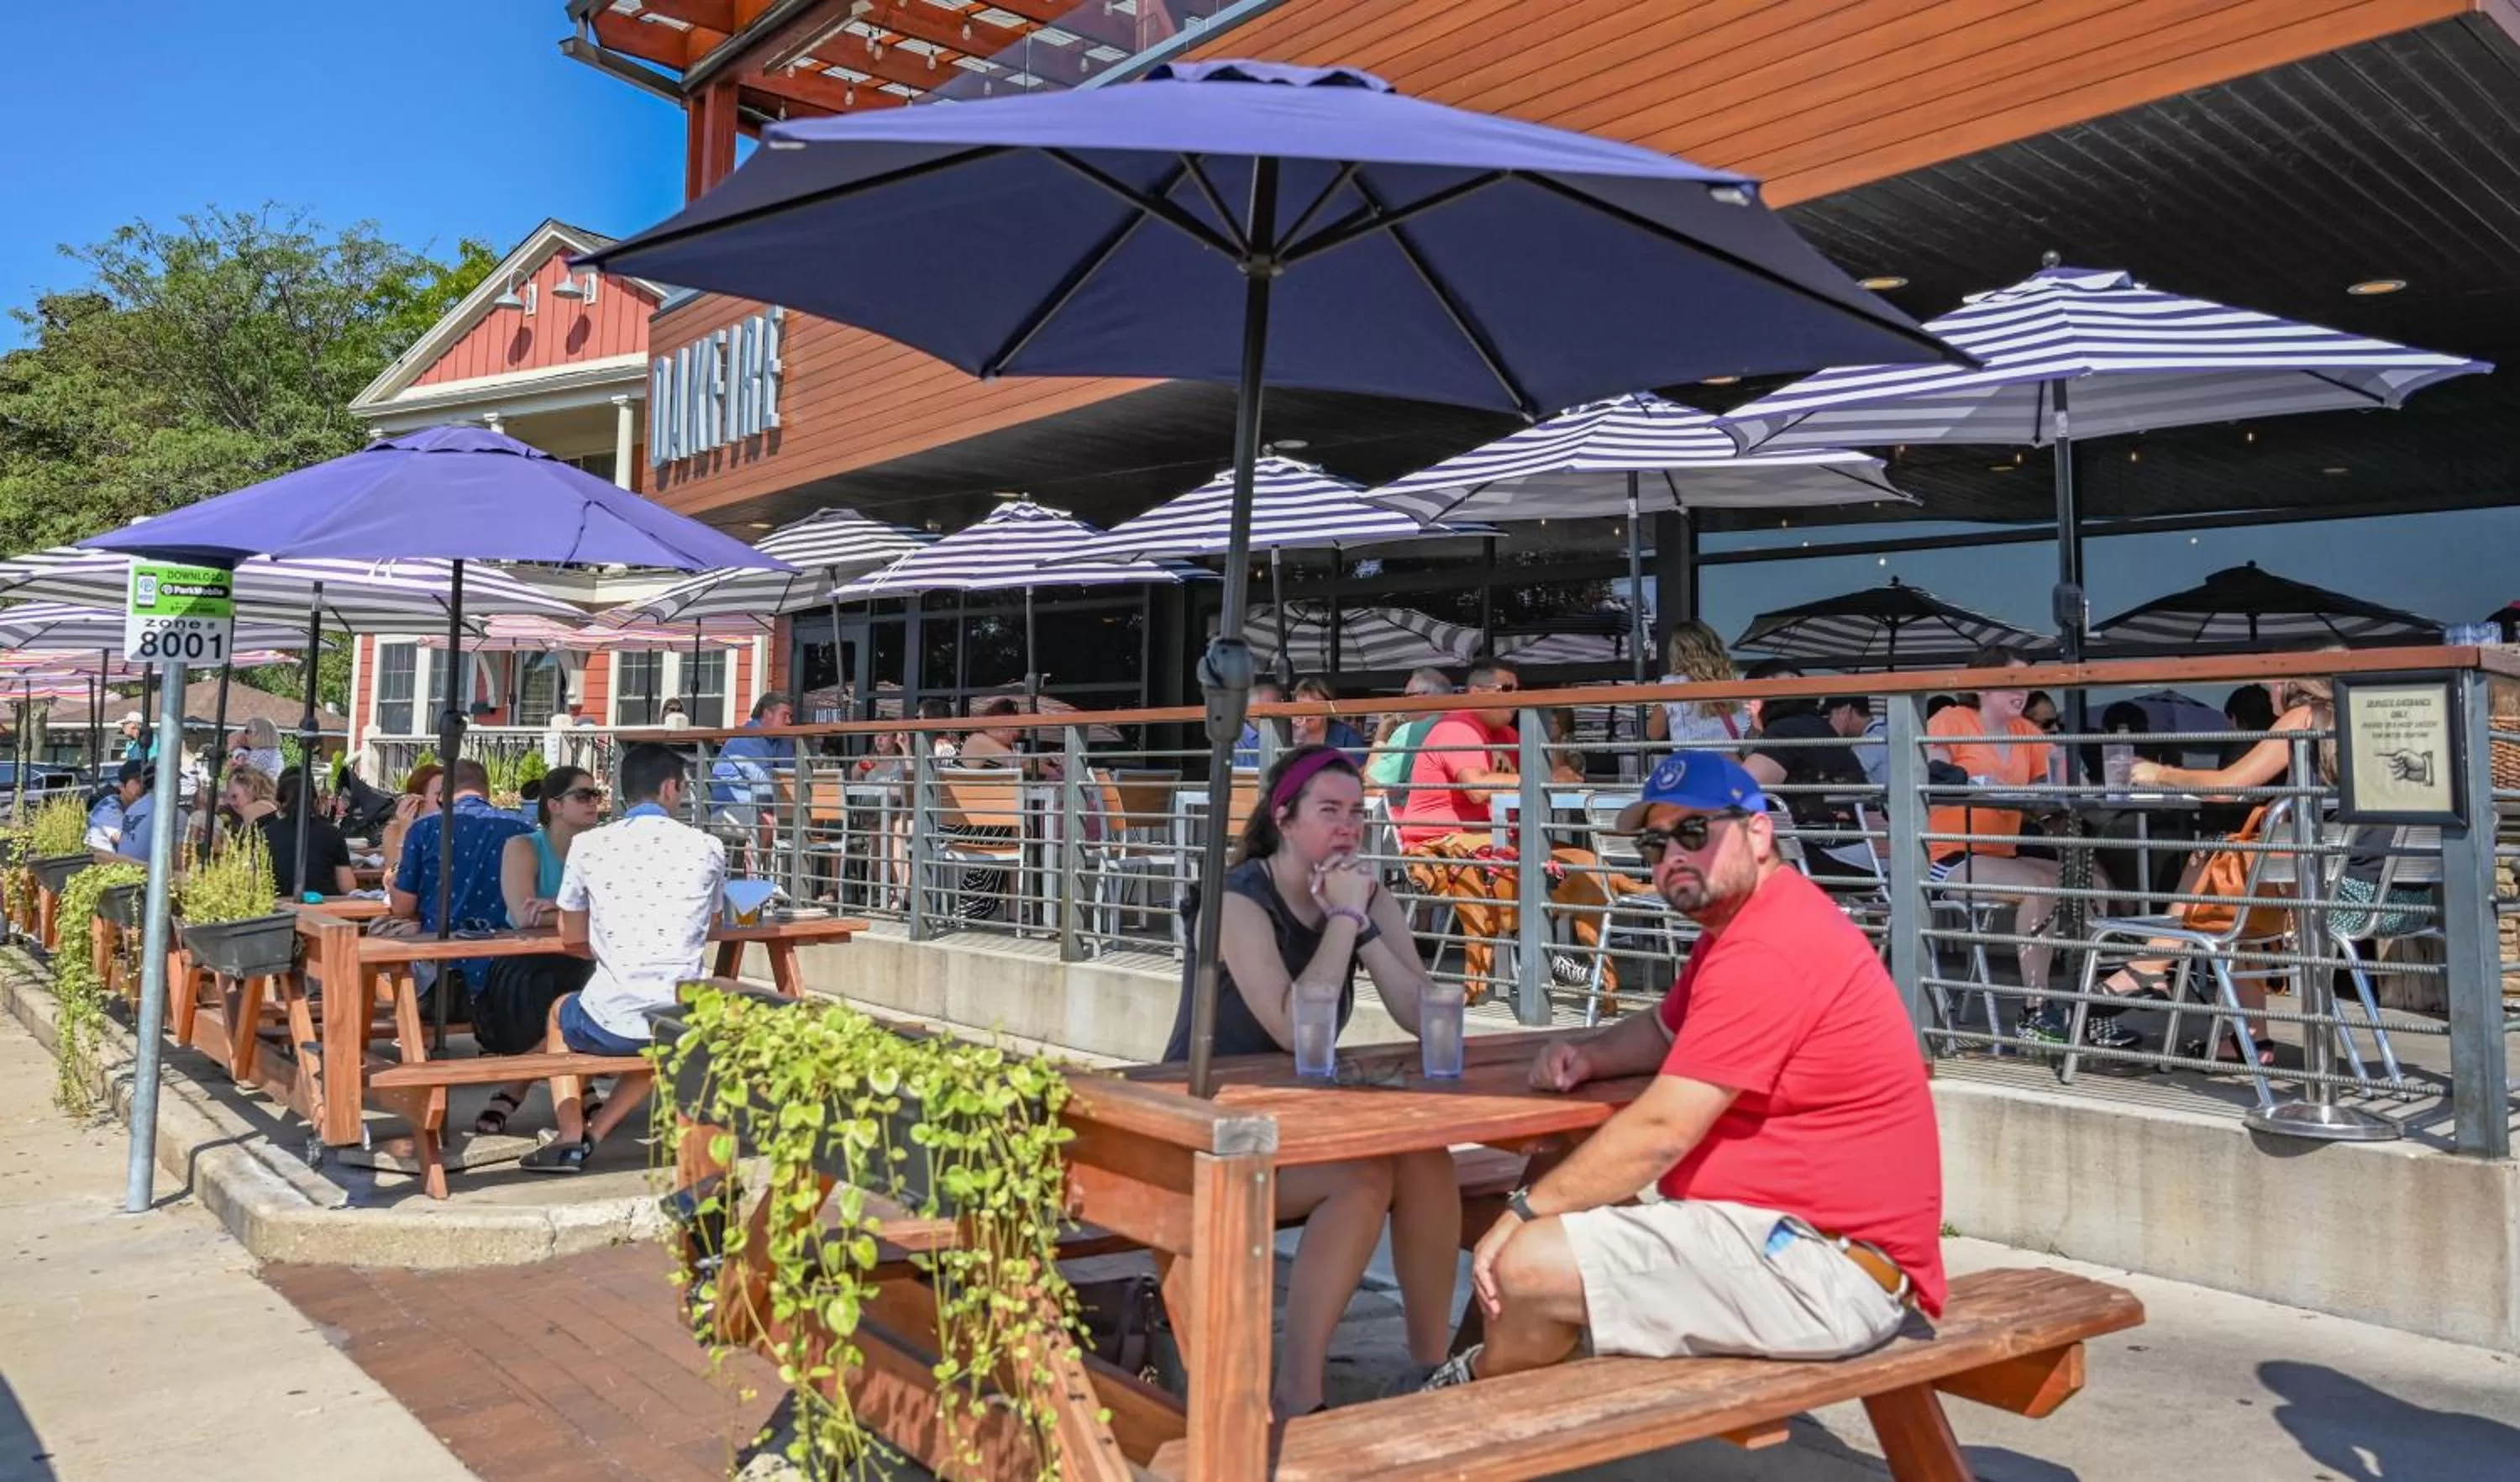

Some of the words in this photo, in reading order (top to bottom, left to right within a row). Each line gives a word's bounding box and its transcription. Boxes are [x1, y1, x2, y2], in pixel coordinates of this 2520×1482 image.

[167, 570, 224, 582] DOWNLOAD
[174, 586, 224, 596] ParkMobile
[145, 618, 202, 630] zone
[139, 631, 222, 660] 8001
